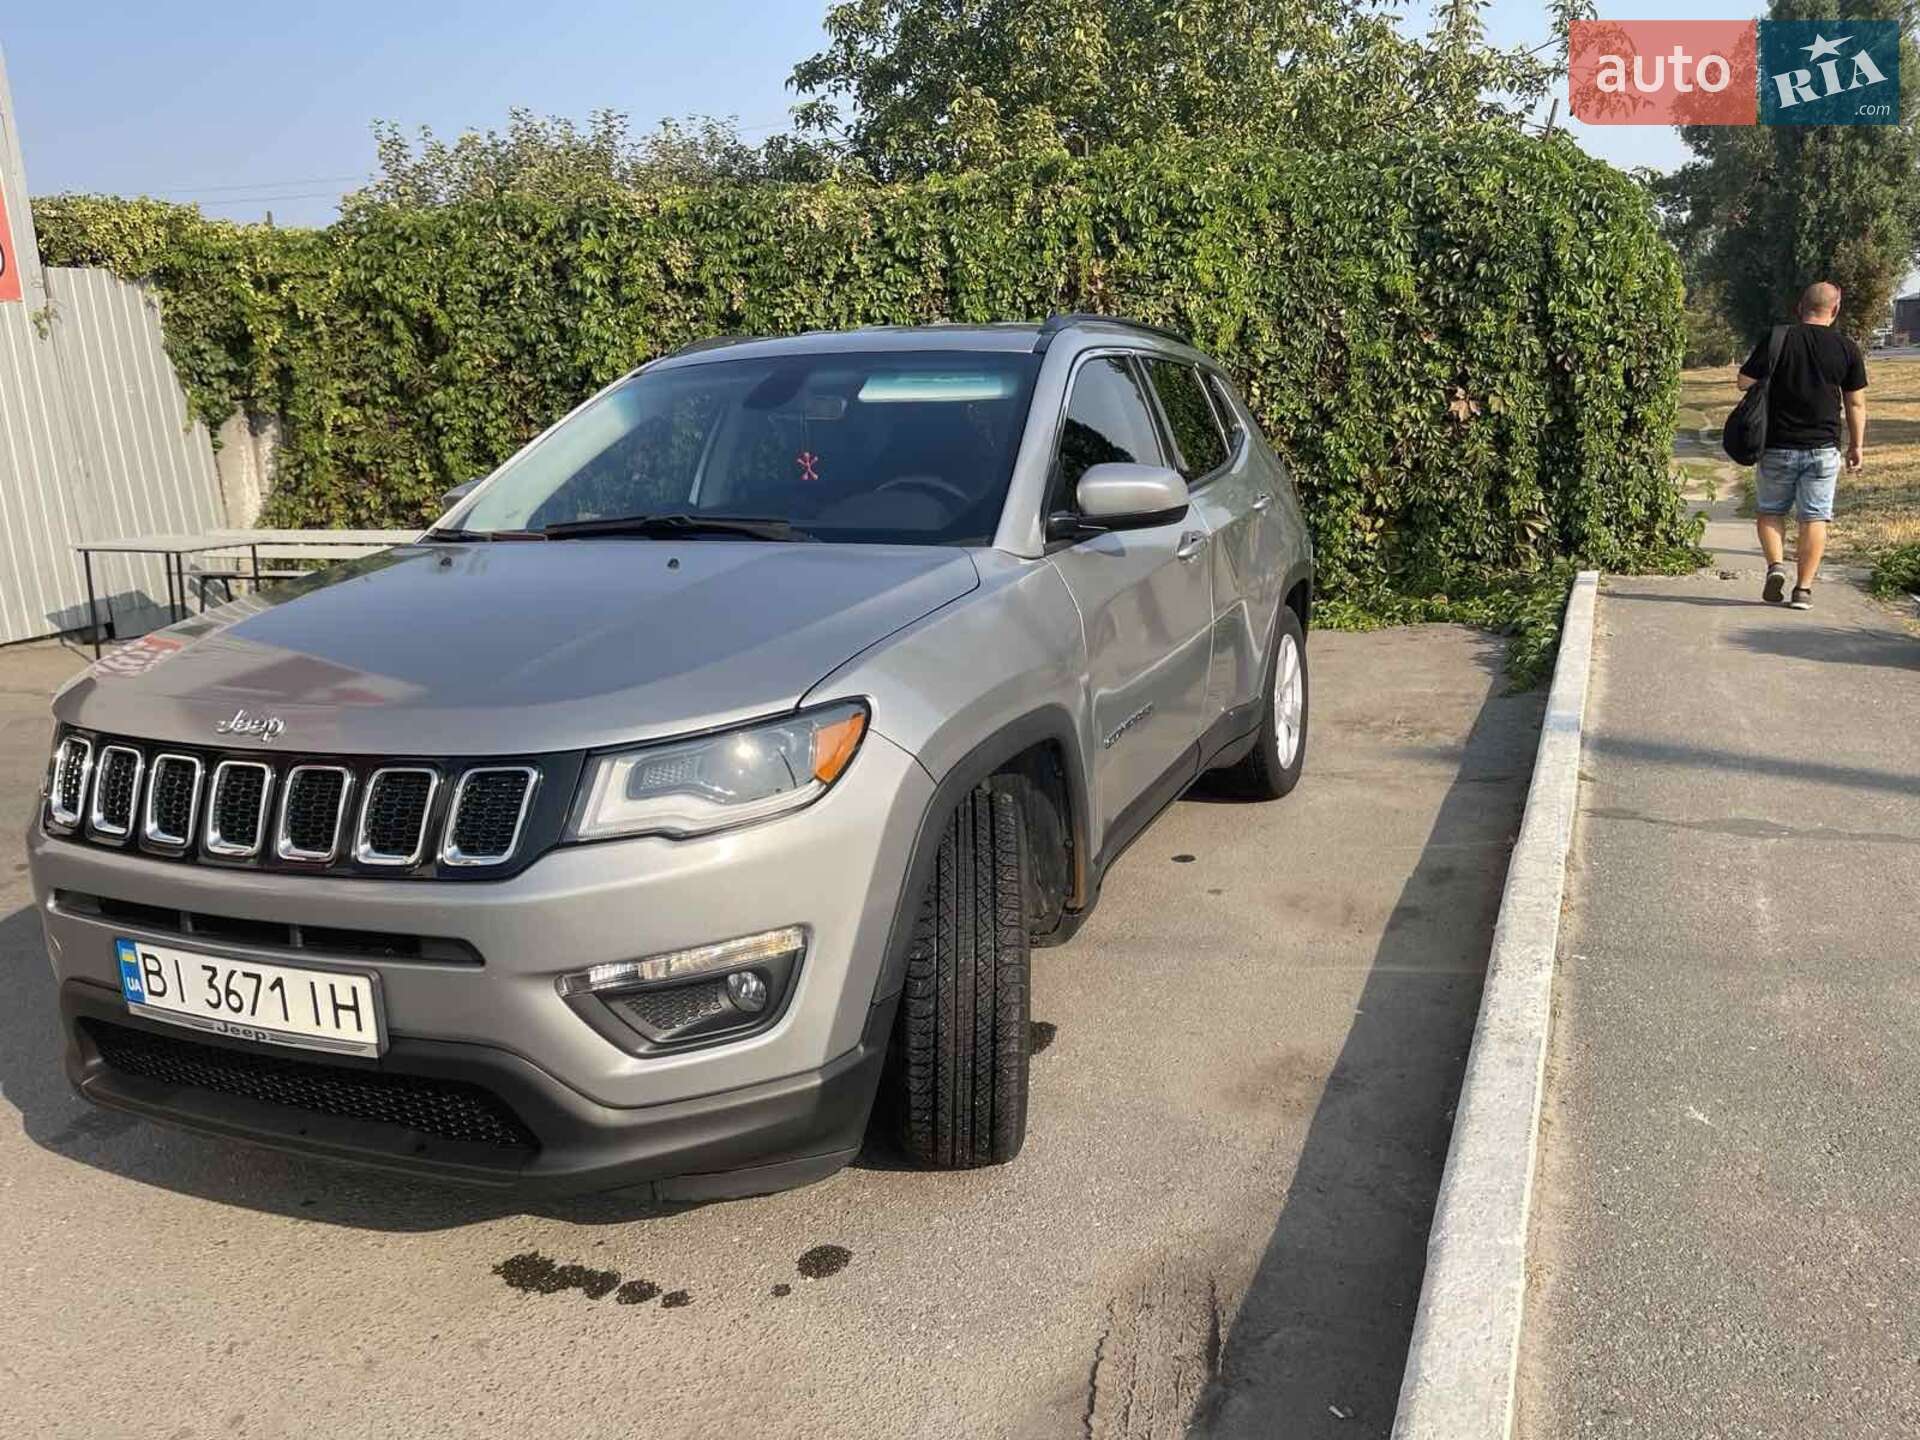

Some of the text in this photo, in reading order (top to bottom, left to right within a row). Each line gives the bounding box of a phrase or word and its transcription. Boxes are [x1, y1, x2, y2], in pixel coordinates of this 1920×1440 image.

[216, 709, 285, 741] Jeep
[127, 976, 142, 992] UA
[142, 952, 363, 1032] BI 3671 IH
[217, 1022, 267, 1041] Jeep
